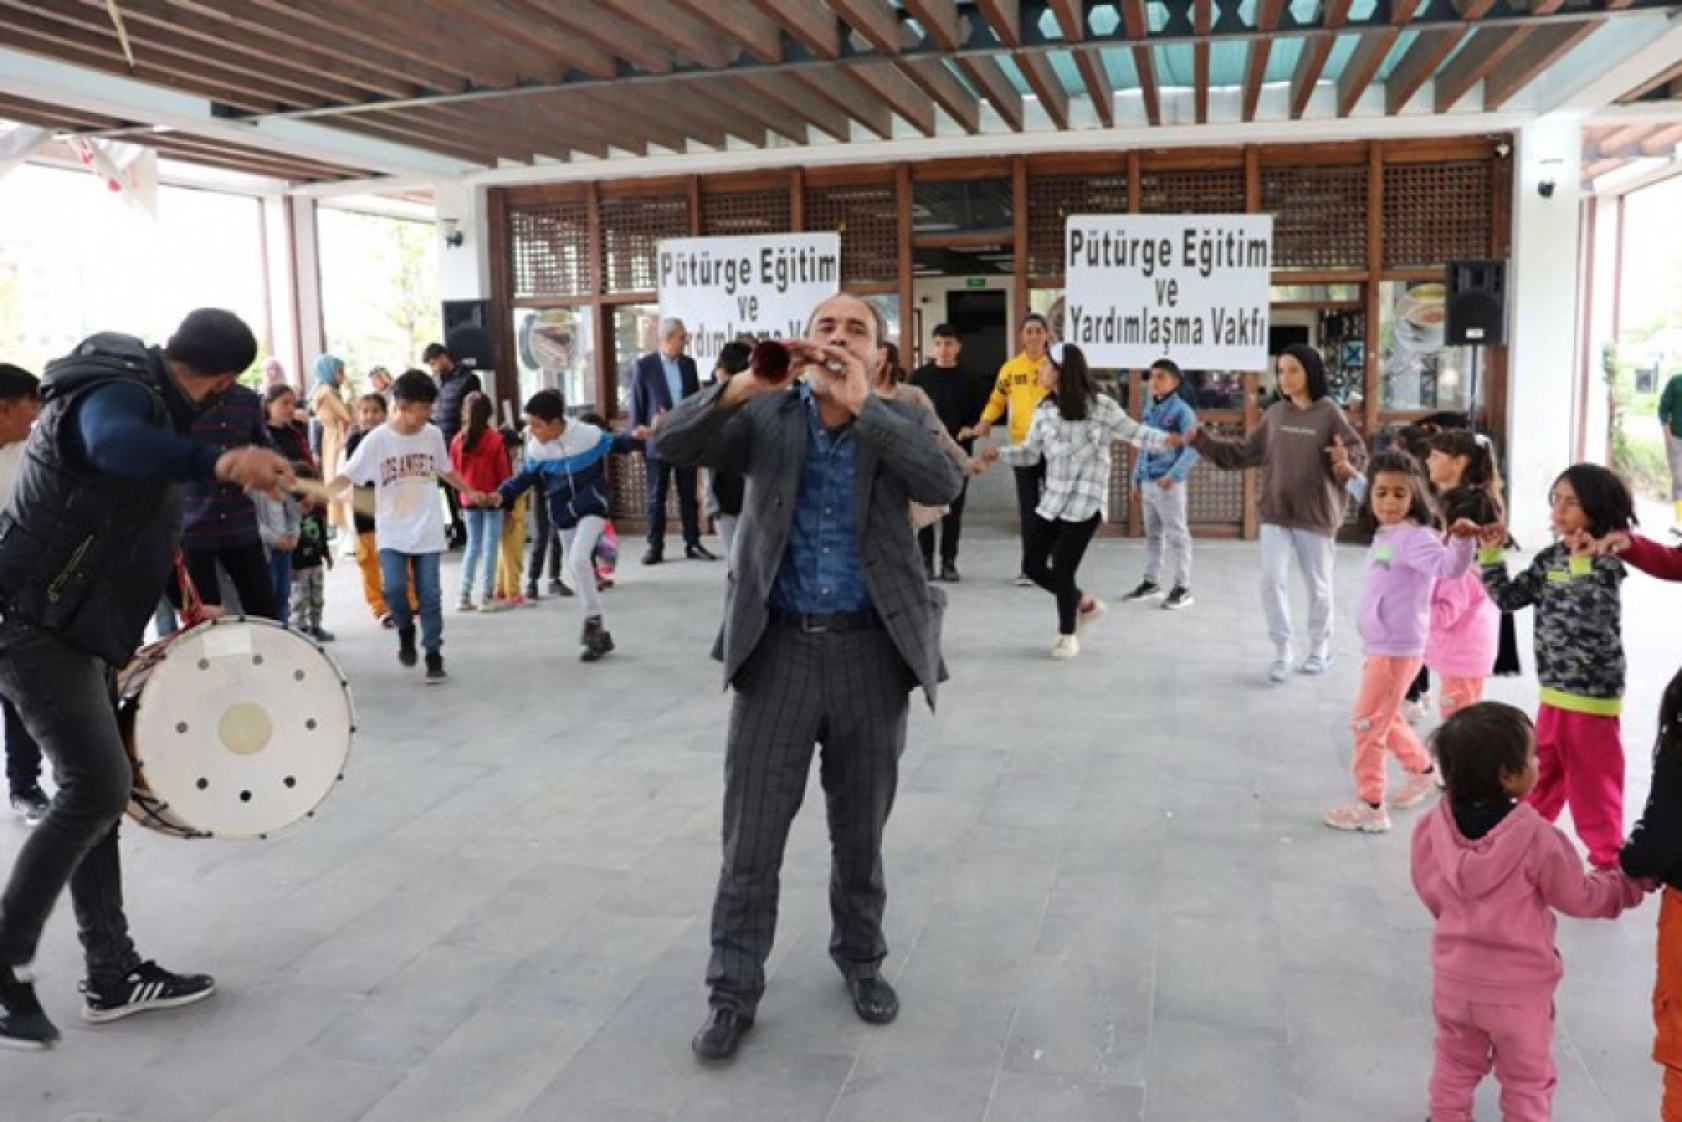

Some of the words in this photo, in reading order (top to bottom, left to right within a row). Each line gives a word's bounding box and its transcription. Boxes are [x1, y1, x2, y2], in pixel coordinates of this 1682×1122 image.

[660, 251, 752, 294] Pütürge
[760, 246, 837, 293] Eğitim
[1070, 229, 1172, 277] Pütürge
[1182, 229, 1267, 277] Eğitim
[737, 295, 759, 322] ve
[1155, 278, 1179, 307] ve
[1070, 306, 1204, 355] Yardımlaşma
[1210, 307, 1265, 346] Vakfı
